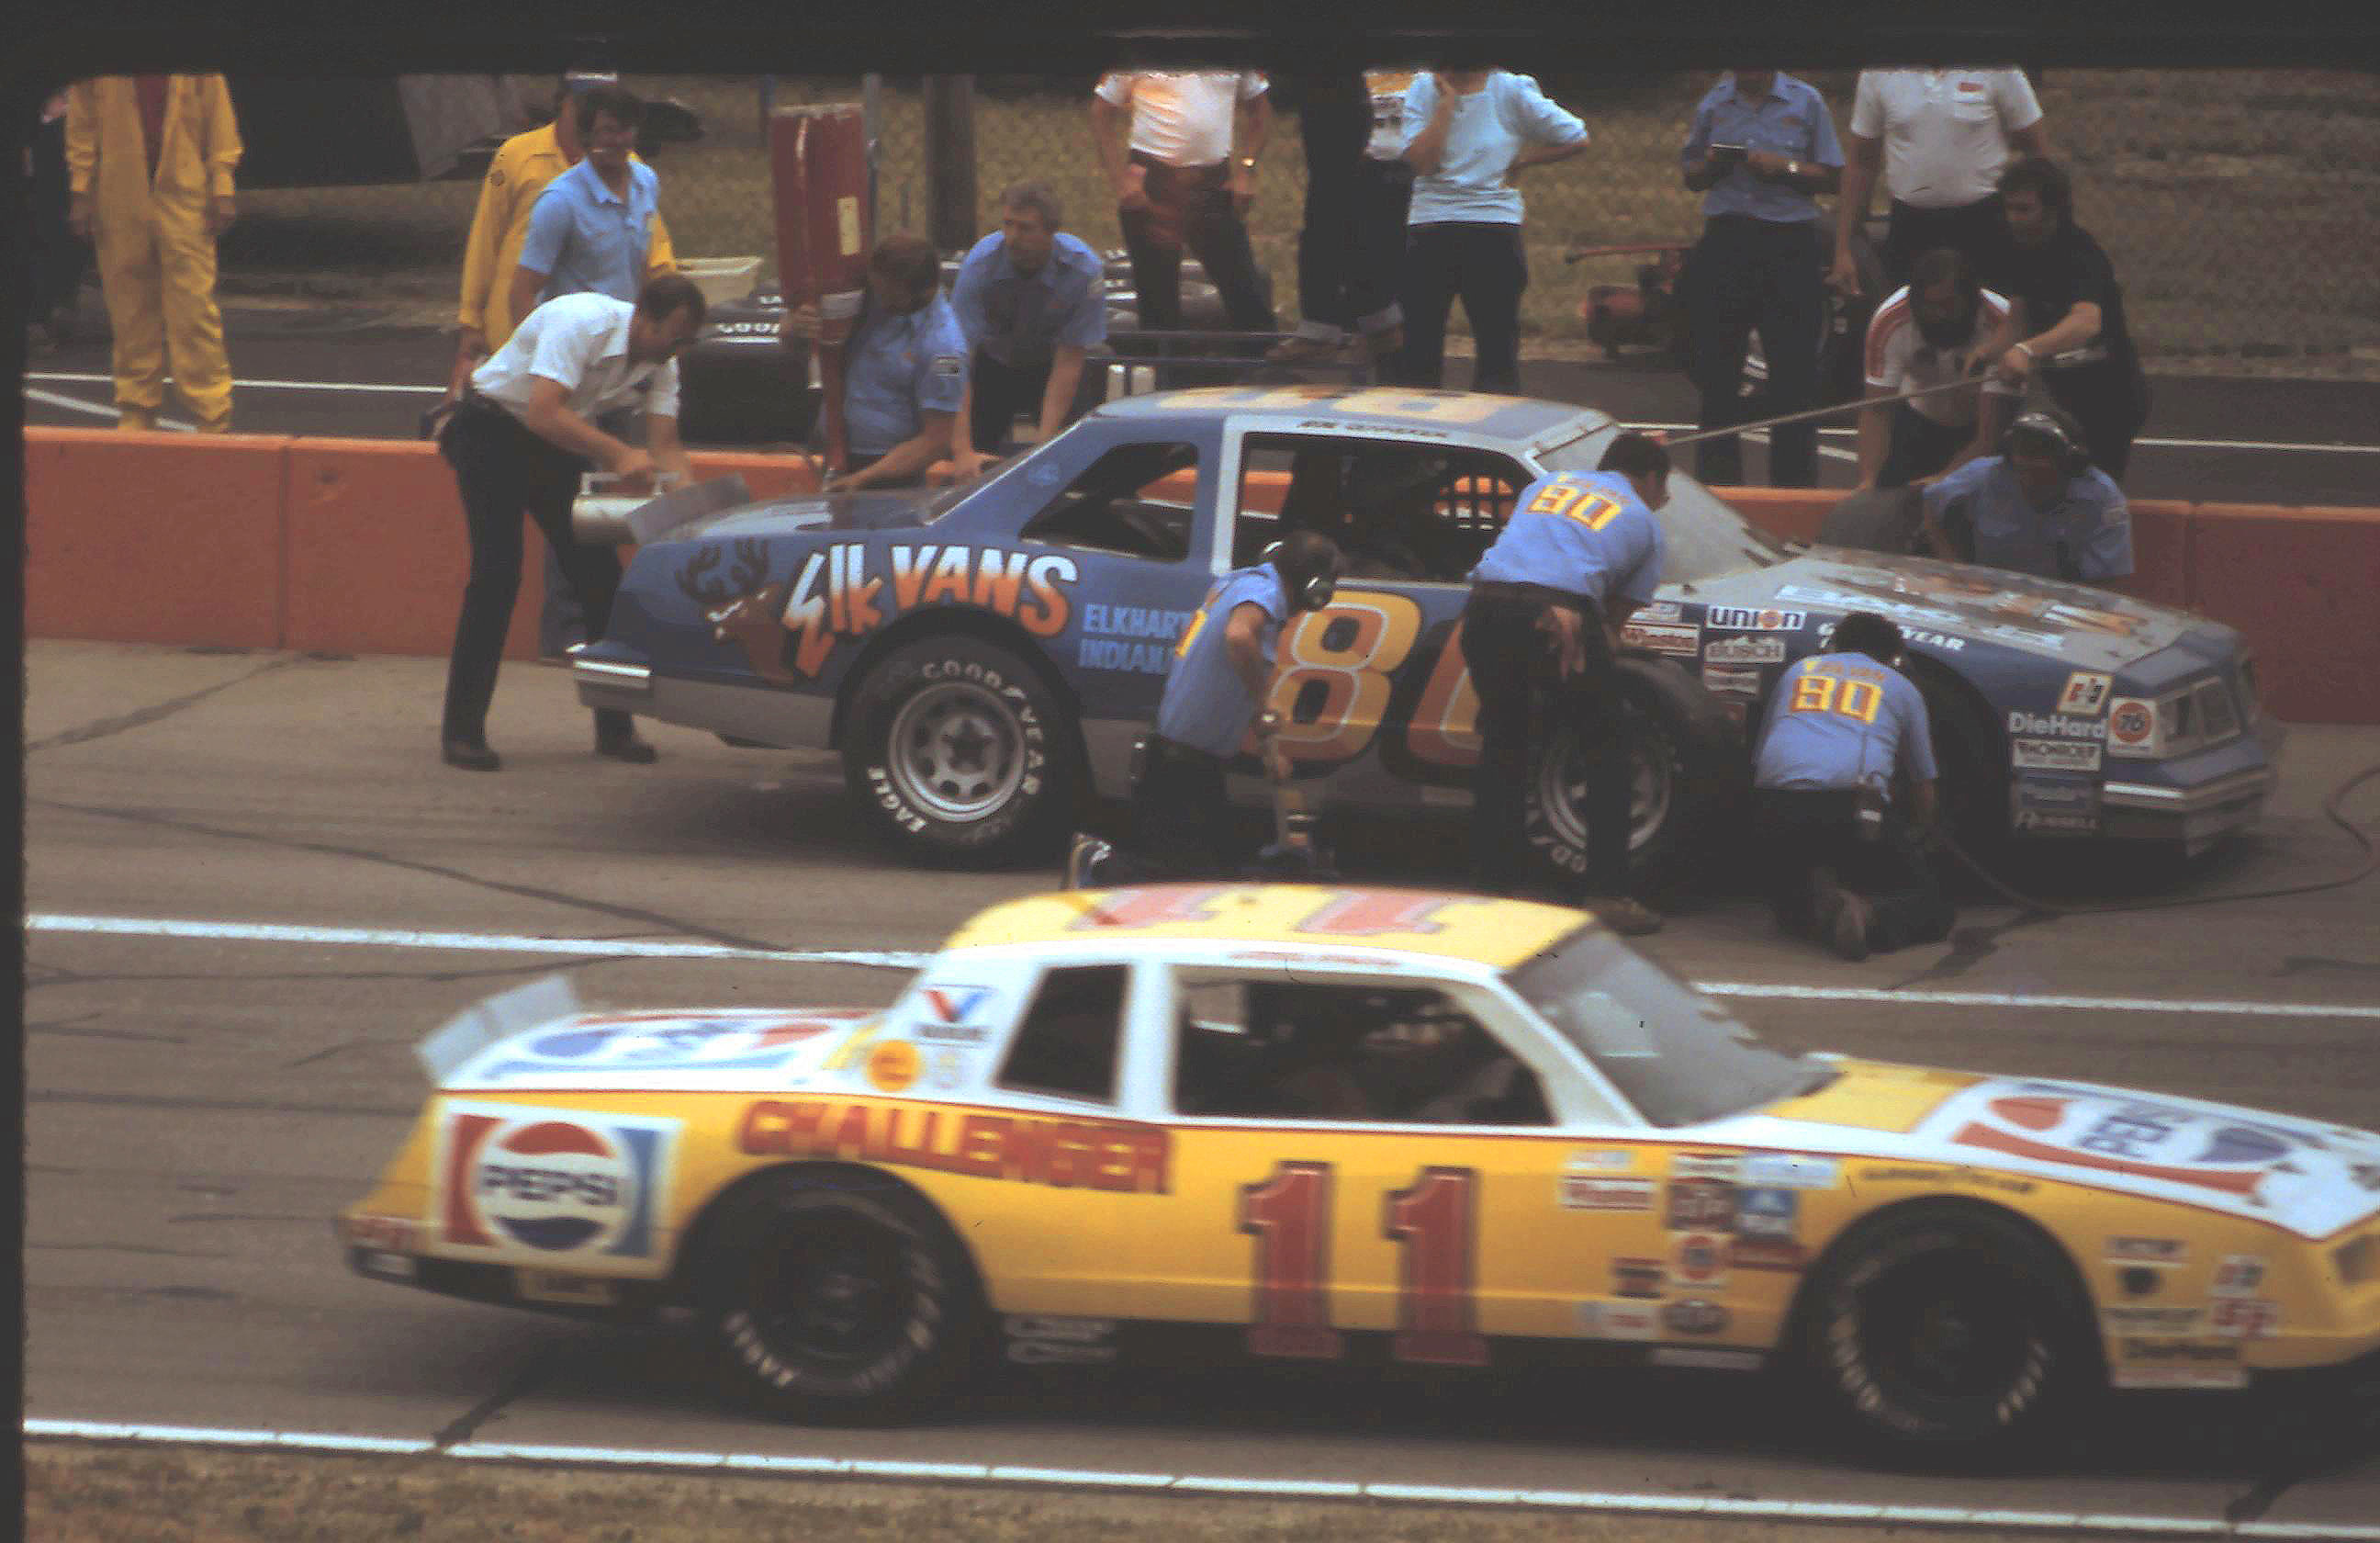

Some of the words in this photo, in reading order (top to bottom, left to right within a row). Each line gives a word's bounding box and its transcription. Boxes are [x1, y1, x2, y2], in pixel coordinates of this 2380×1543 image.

[891, 546, 1079, 636] VANS
[1077, 639, 1176, 675] INDIAN
[738, 1099, 1176, 1197] CHALLENGER
[1237, 1159, 1493, 1368] 11
